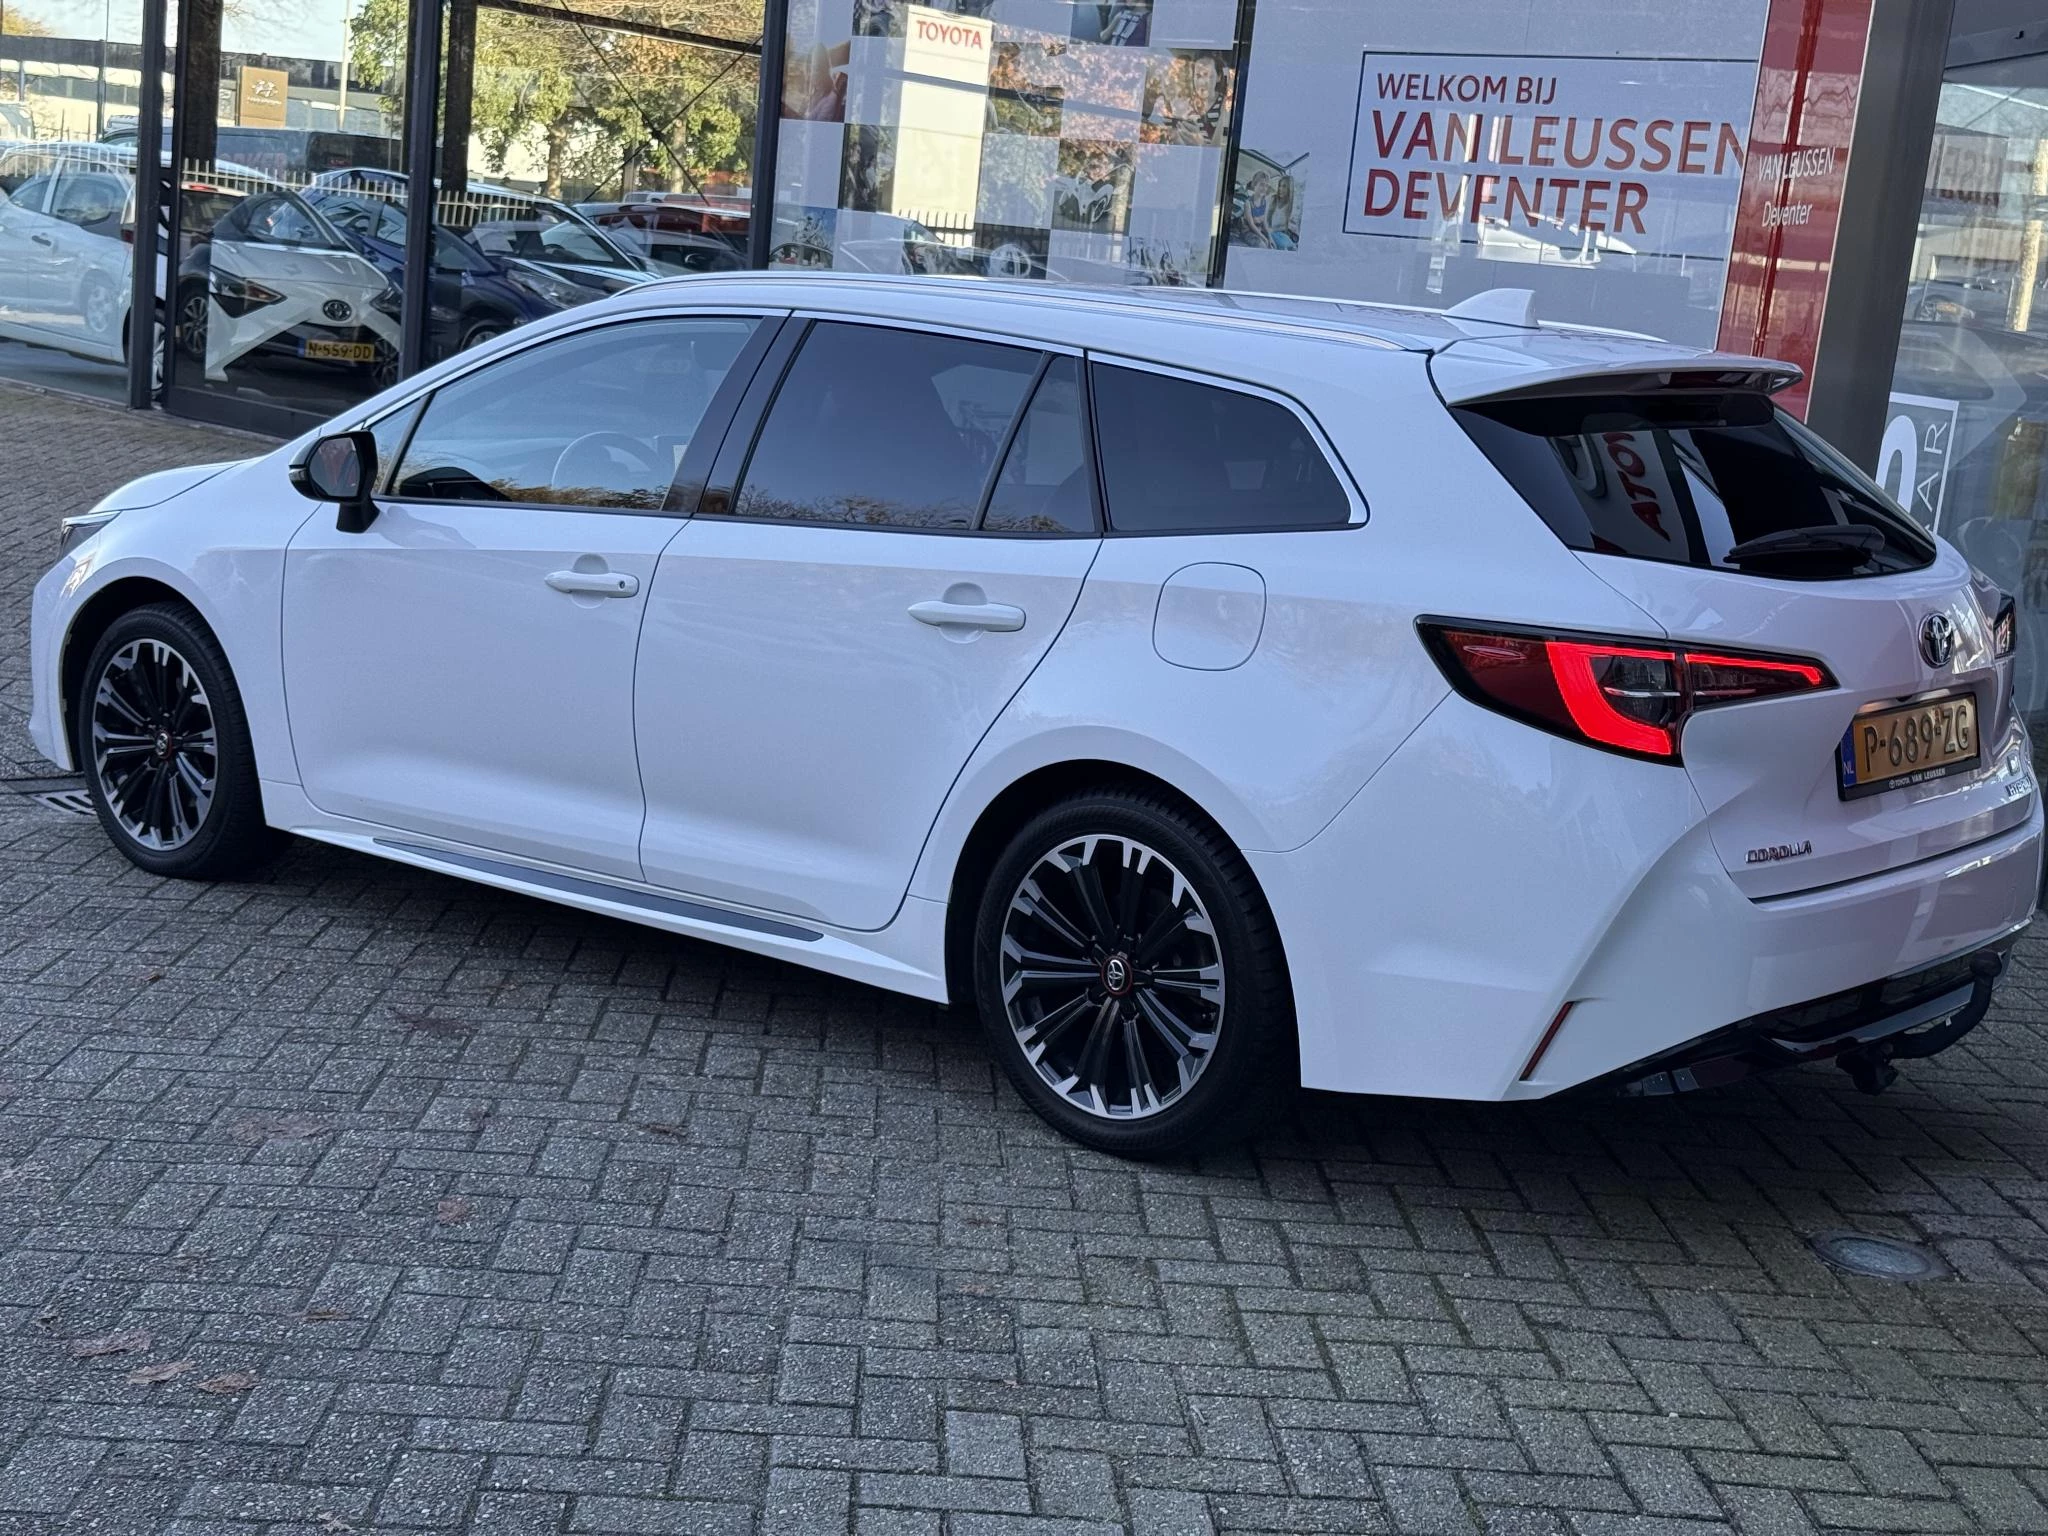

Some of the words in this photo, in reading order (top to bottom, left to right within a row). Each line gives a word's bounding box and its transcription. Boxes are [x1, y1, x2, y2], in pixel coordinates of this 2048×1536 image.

[916, 20, 982, 49] TOYOTA
[1377, 73, 1508, 103] WELKOM
[1516, 76, 1557, 105] BIJ
[1372, 110, 1483, 163] VAN
[1759, 153, 1782, 181] VAN
[1780, 146, 1836, 180] LEUSSEN
[1364, 168, 1648, 234] DEVENTER
[1761, 201, 1813, 228] Deventer
[1911, 773, 1923, 783] VAN
[1745, 839, 1813, 864] COROLLA
